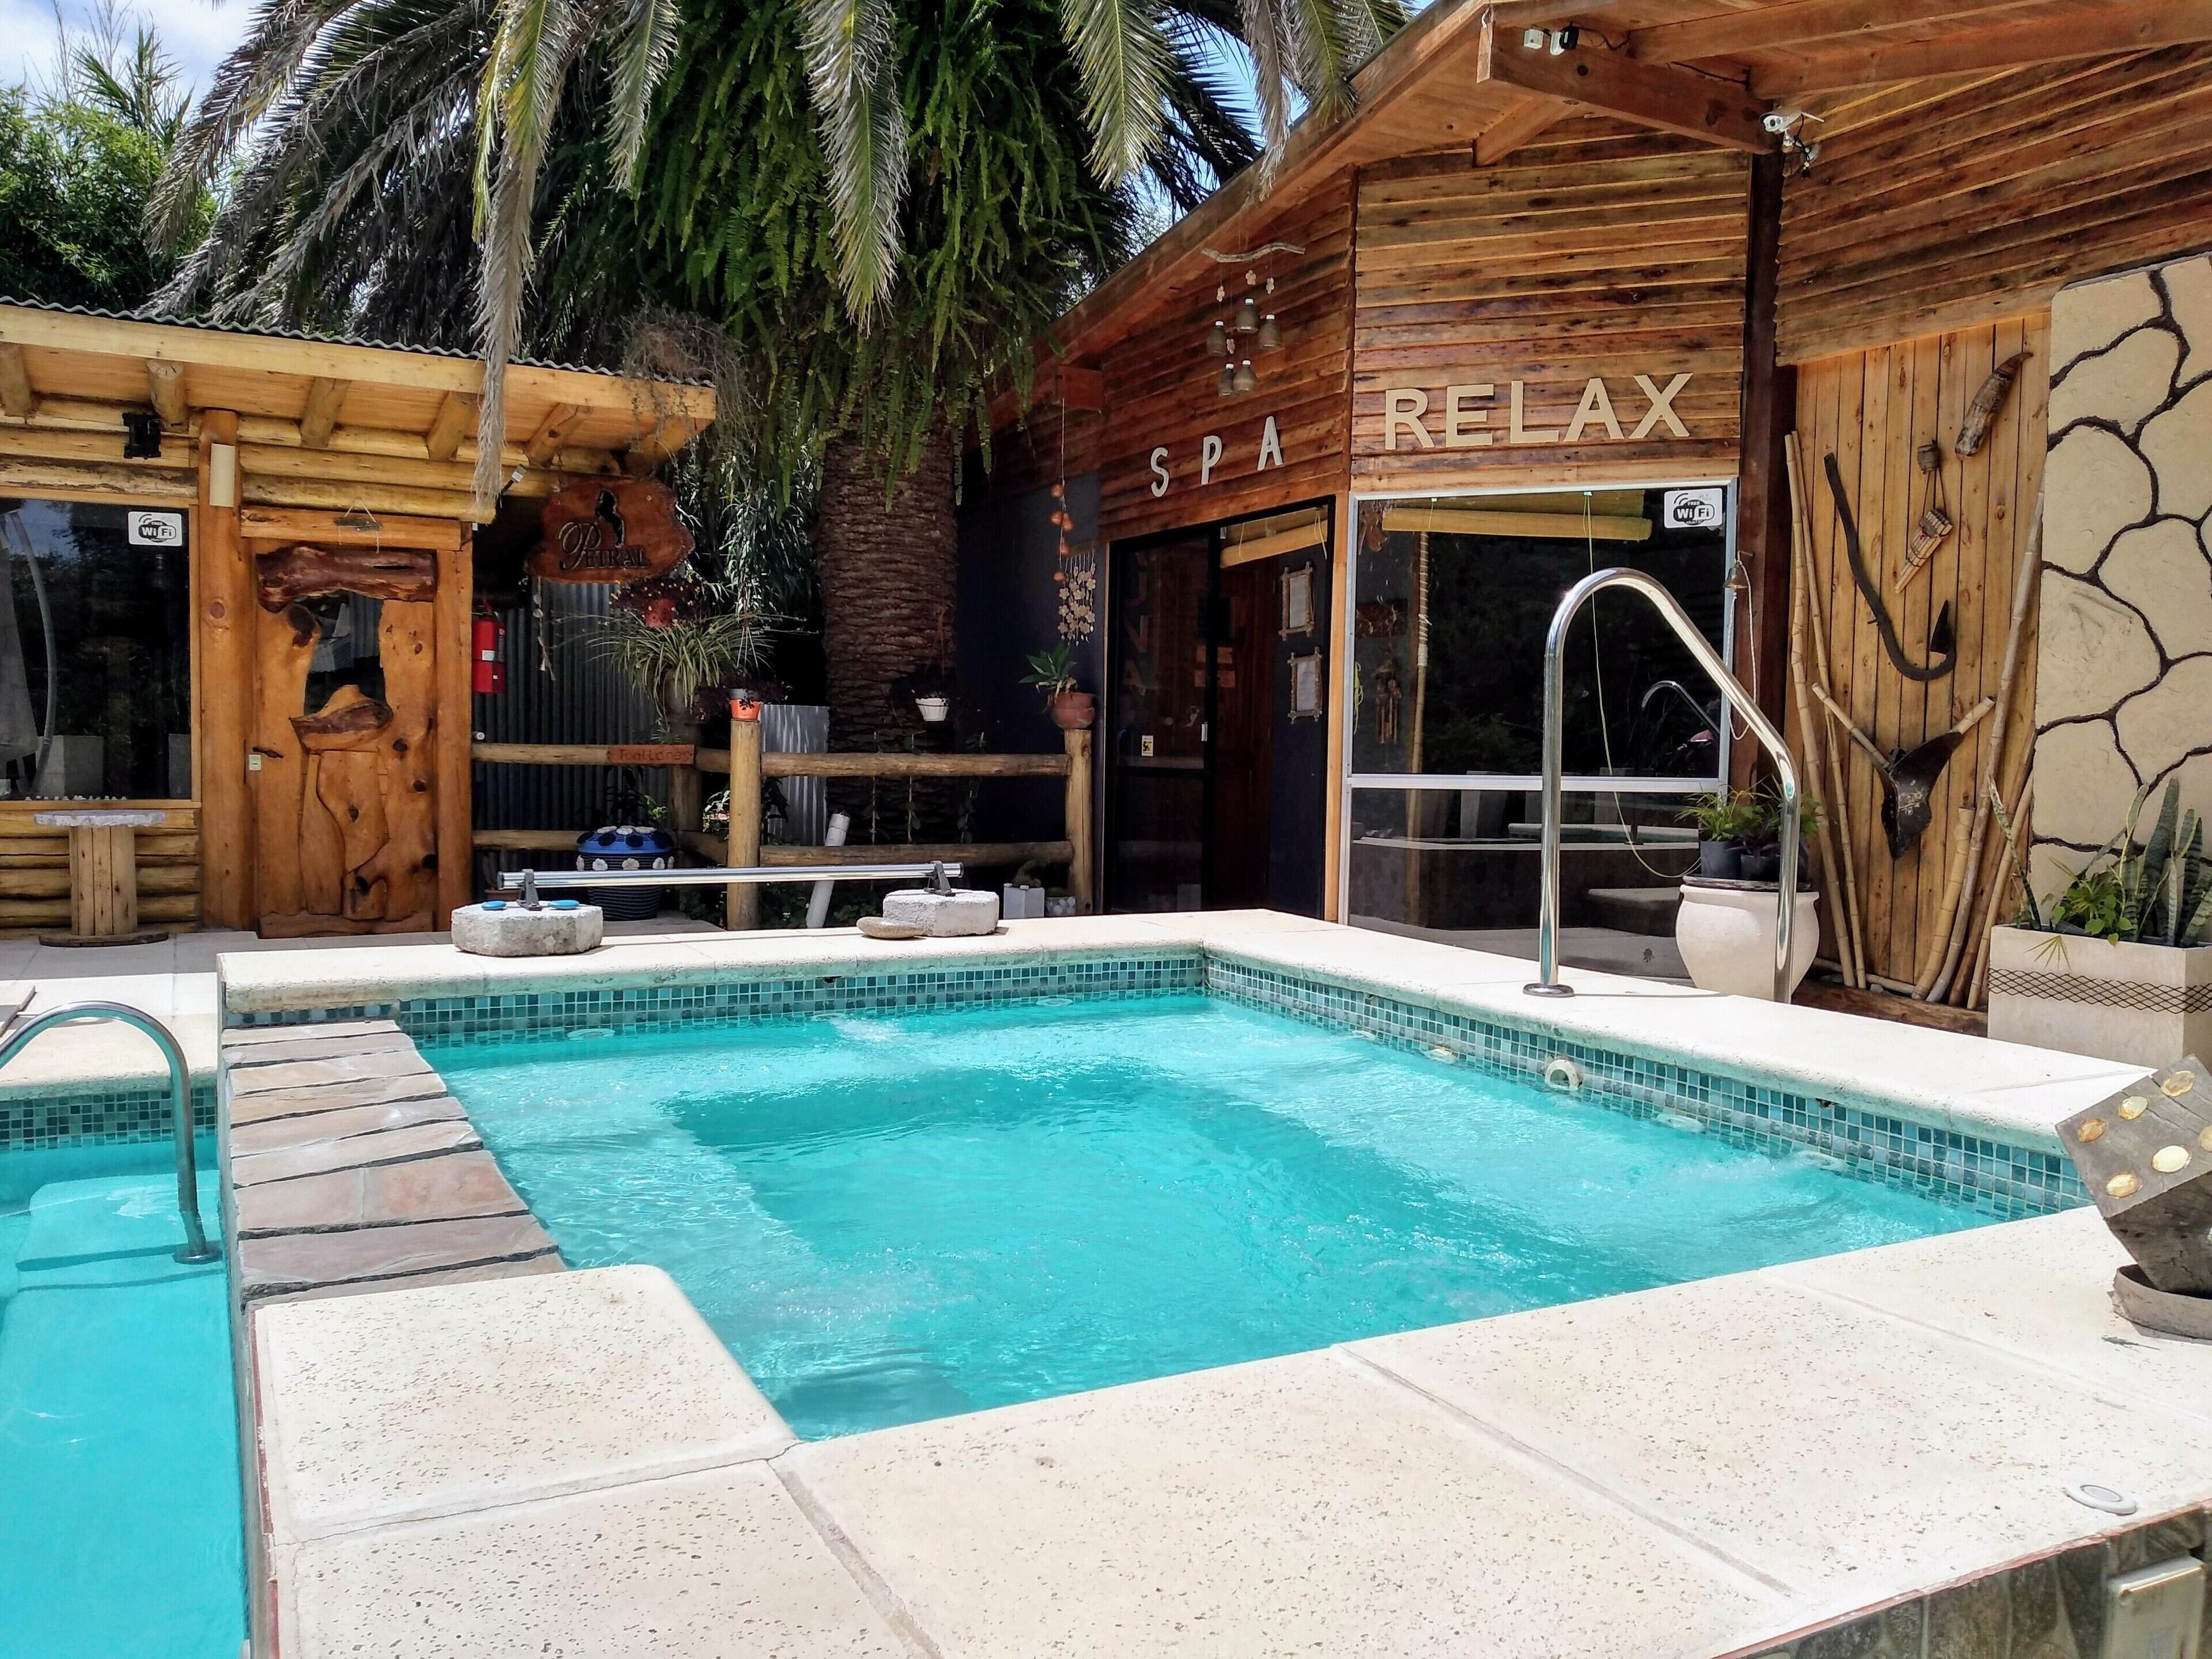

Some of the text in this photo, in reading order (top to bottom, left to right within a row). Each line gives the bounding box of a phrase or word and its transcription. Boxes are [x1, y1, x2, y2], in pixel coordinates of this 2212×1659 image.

[1385, 373, 1694, 450] RELAX
[1150, 415, 1284, 498] SPA
[558, 521, 650, 571] PETRAL
